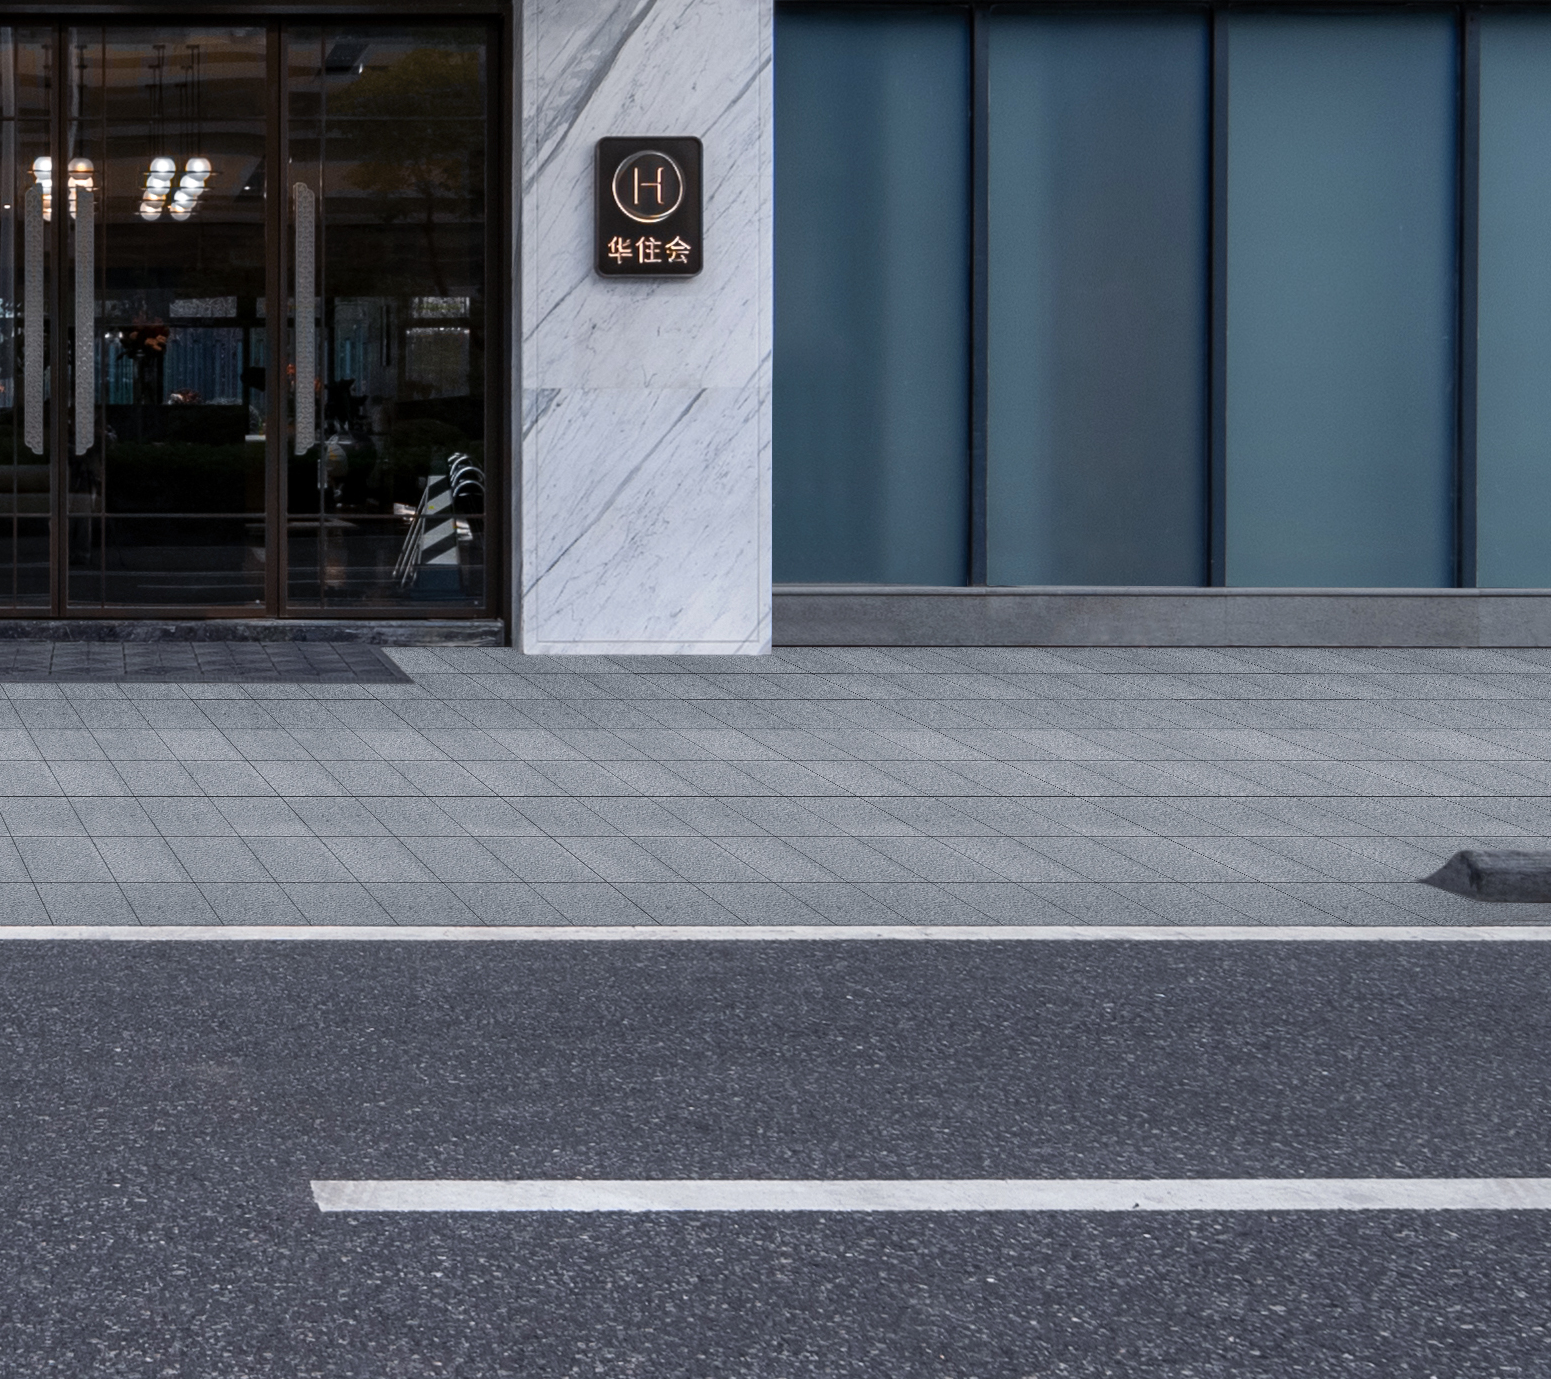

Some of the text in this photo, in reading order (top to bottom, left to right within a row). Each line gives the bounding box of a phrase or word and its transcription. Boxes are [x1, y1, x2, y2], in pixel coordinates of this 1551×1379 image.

[632, 166, 665, 205] H
[607, 235, 693, 265] 华住会
